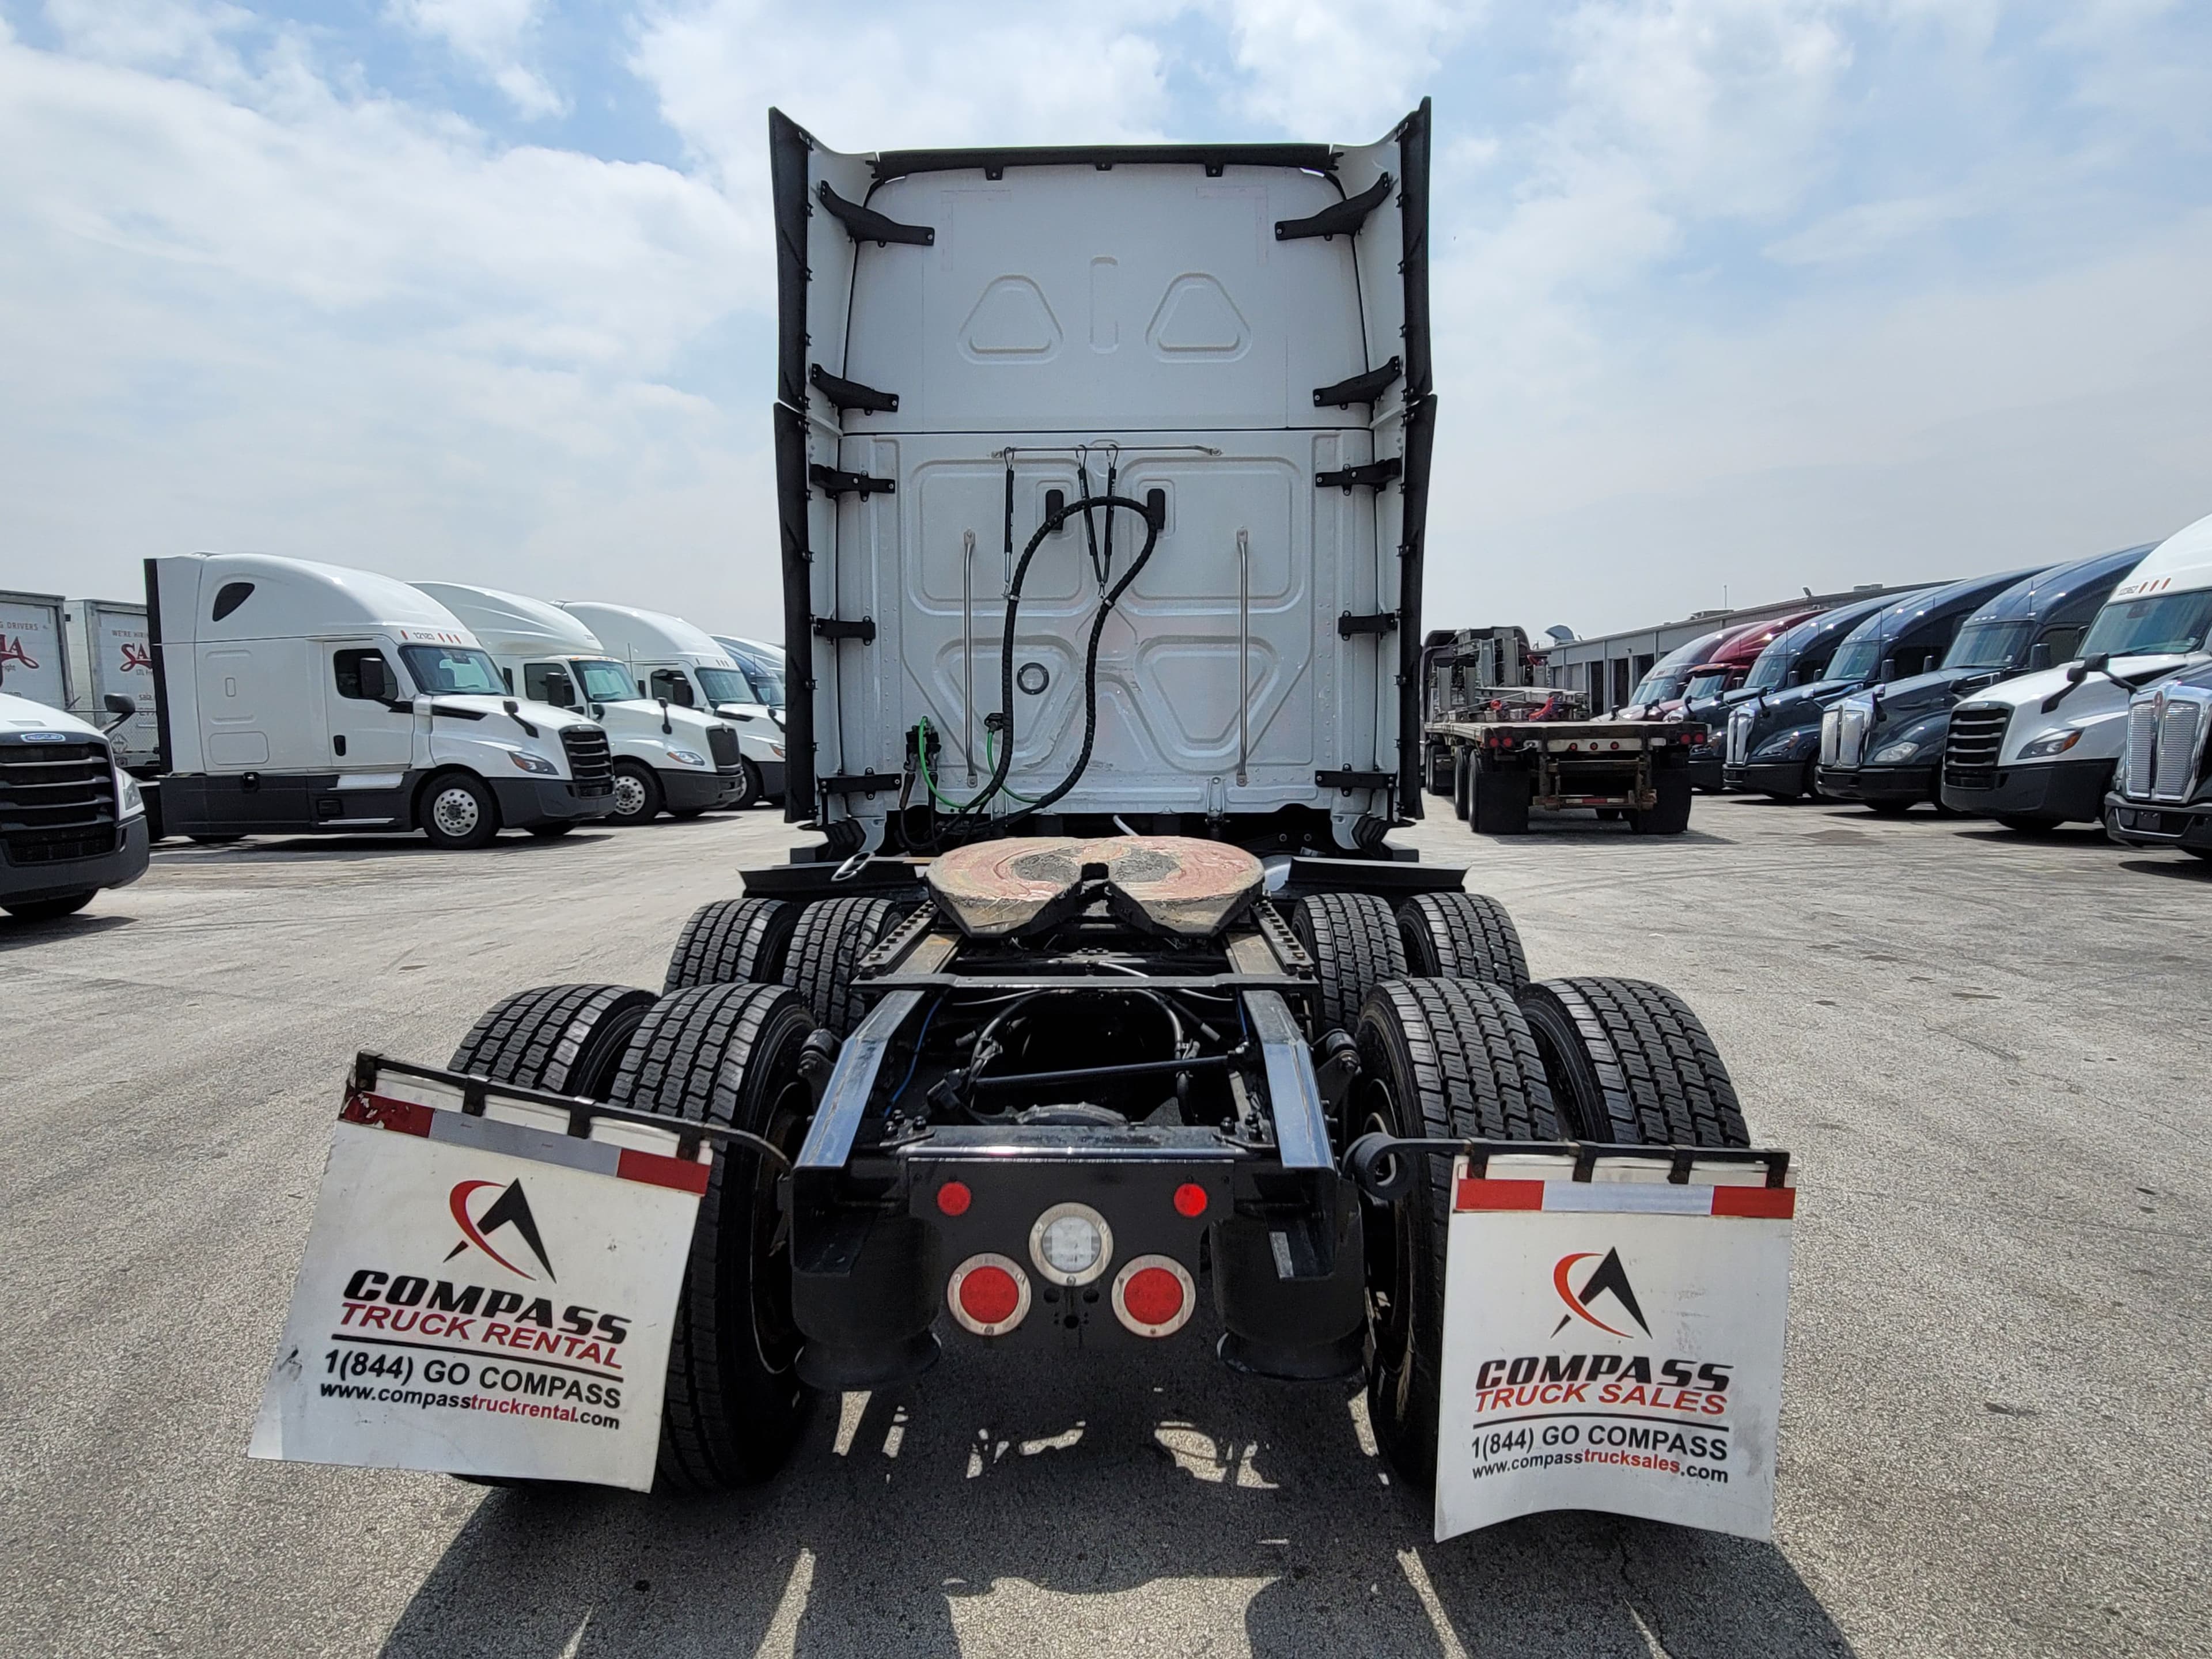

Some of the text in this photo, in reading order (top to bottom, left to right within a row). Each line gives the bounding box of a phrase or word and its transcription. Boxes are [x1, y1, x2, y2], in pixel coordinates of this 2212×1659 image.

[7, 622, 39, 631] DRIVERS
[343, 1269, 632, 1344] COMPASS
[340, 1302, 623, 1370] TRUCK RENTAL
[325, 1349, 622, 1410] 1(844) GO COMPASS
[1475, 1355, 1734, 1392] COMPASS
[320, 1383, 620, 1430] www.compasstruckrental.com
[1475, 1382, 1728, 1415] TRUCK SALES
[1471, 1424, 1728, 1462] 1(844) GO COMPASS
[1472, 1448, 1729, 1484] www.compasstrucksales.com
